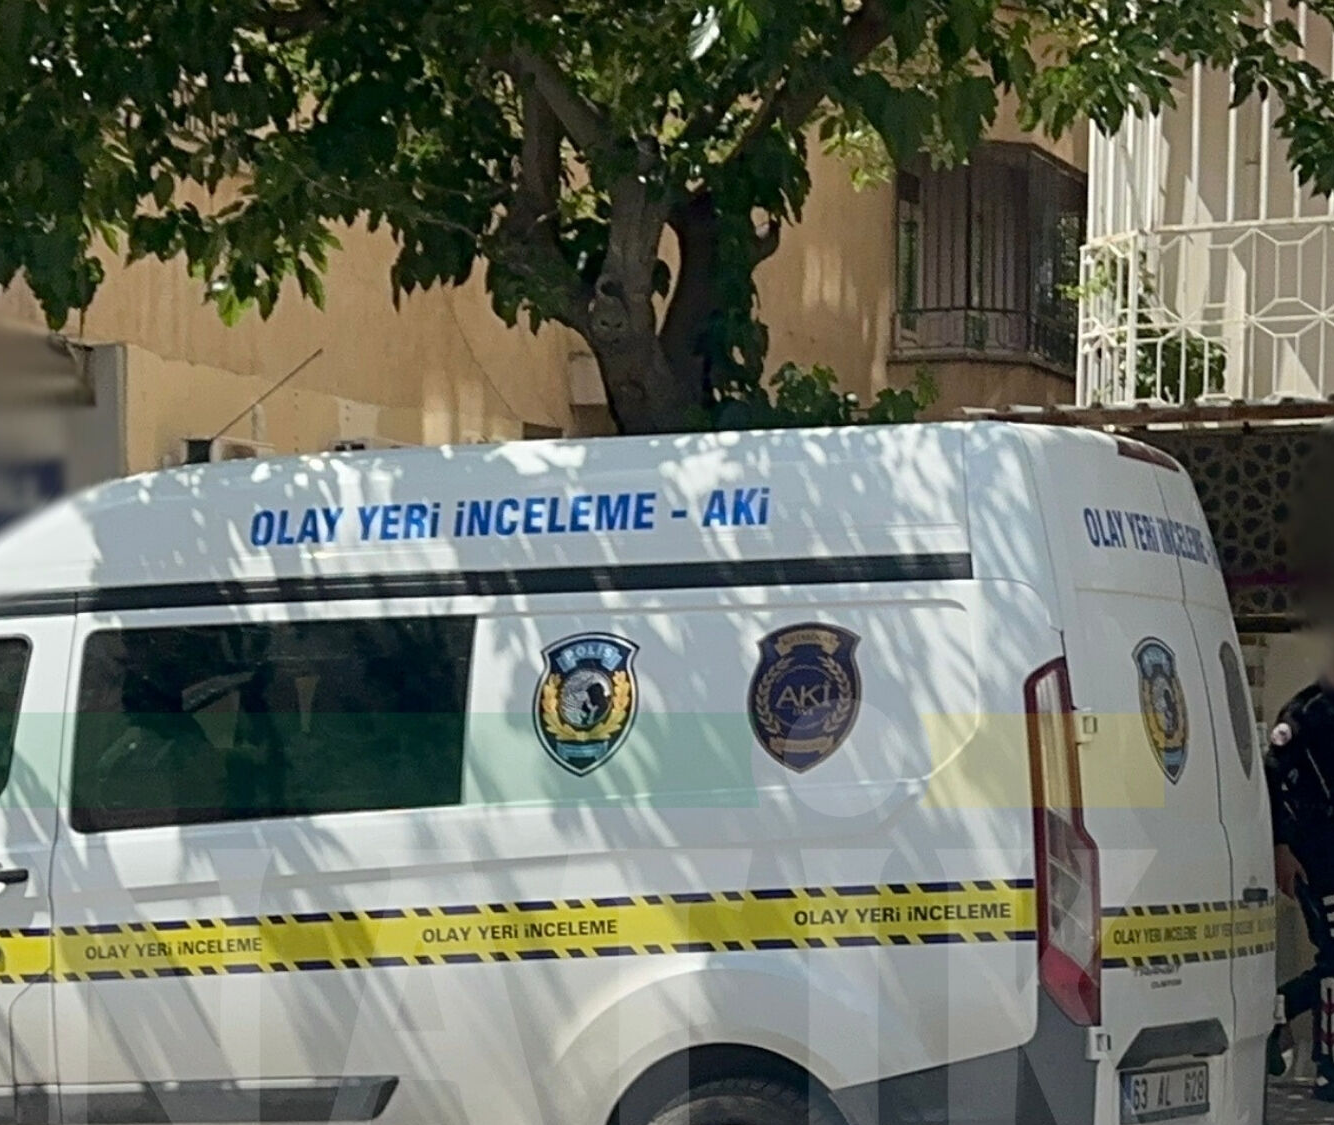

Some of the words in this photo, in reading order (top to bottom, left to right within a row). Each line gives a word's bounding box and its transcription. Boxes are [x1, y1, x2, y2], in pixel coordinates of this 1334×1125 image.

[250, 507, 344, 546] OLAY
[1083, 507, 1128, 548] OLAY
[794, 909, 848, 926] OLAY
[422, 926, 471, 943] OLAY
[1113, 929, 1142, 945] OLAY
[85, 944, 129, 960] OLAY
[1133, 1078, 1148, 1111] 63
[1157, 1075, 1172, 1107] AL
